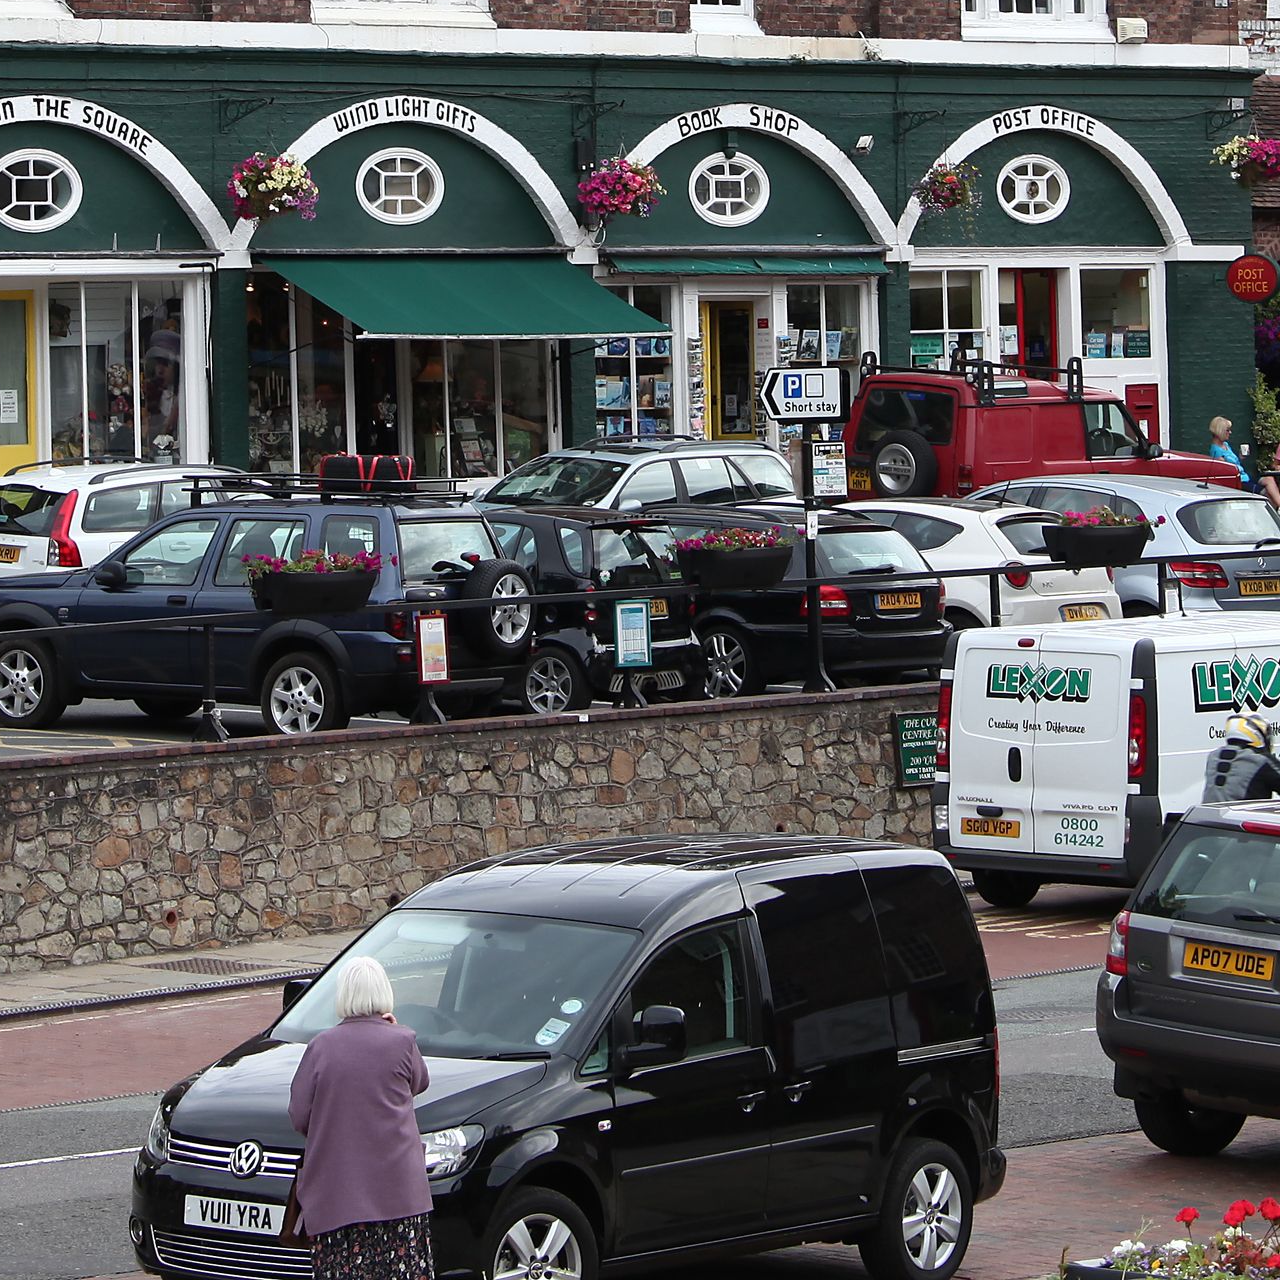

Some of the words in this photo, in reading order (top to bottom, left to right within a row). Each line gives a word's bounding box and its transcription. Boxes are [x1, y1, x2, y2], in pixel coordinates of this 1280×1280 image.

[385, 98, 430, 118] LIGHT
[436, 102, 477, 133] GIFTS
[677, 107, 723, 137] BOOK
[750, 106, 799, 136] SHOP
[992, 109, 1031, 134] POST
[1040, 108, 1096, 136] OFFICE
[33, 98, 71, 119] THE
[82, 105, 153, 156] SQUARE
[1238, 269, 1264, 280] POST
[1234, 282, 1269, 293] OFFICE
[788, 376, 800, 396] P
[784, 401, 813, 412] Short
[816, 401, 837, 413] stay
[852, 480, 867, 489] HNT
[0, 547, 16, 560] XRU
[879, 594, 902, 607] RA04
[903, 593, 919, 605] XDZ
[986, 662, 1093, 704] LEXON
[904, 719, 920, 729] THE
[988, 718, 1019, 732] Creating
[1022, 720, 1042, 732] Your
[1045, 721, 1086, 734] Difference
[902, 729, 933, 741] CENTRE
[910, 757, 922, 766] 200
[957, 795, 995, 804] VAUXHALL
[1062, 803, 1094, 811] VIVARO
[966, 819, 990, 833] SG10
[991, 821, 1013, 834] VGP
[1061, 817, 1099, 832] 0800
[1054, 833, 1104, 848] 614242
[1190, 947, 1232, 969] AP07
[1234, 952, 1267, 976] UDE
[199, 1199, 231, 1225] VU11
[237, 1203, 272, 1230] YRA
